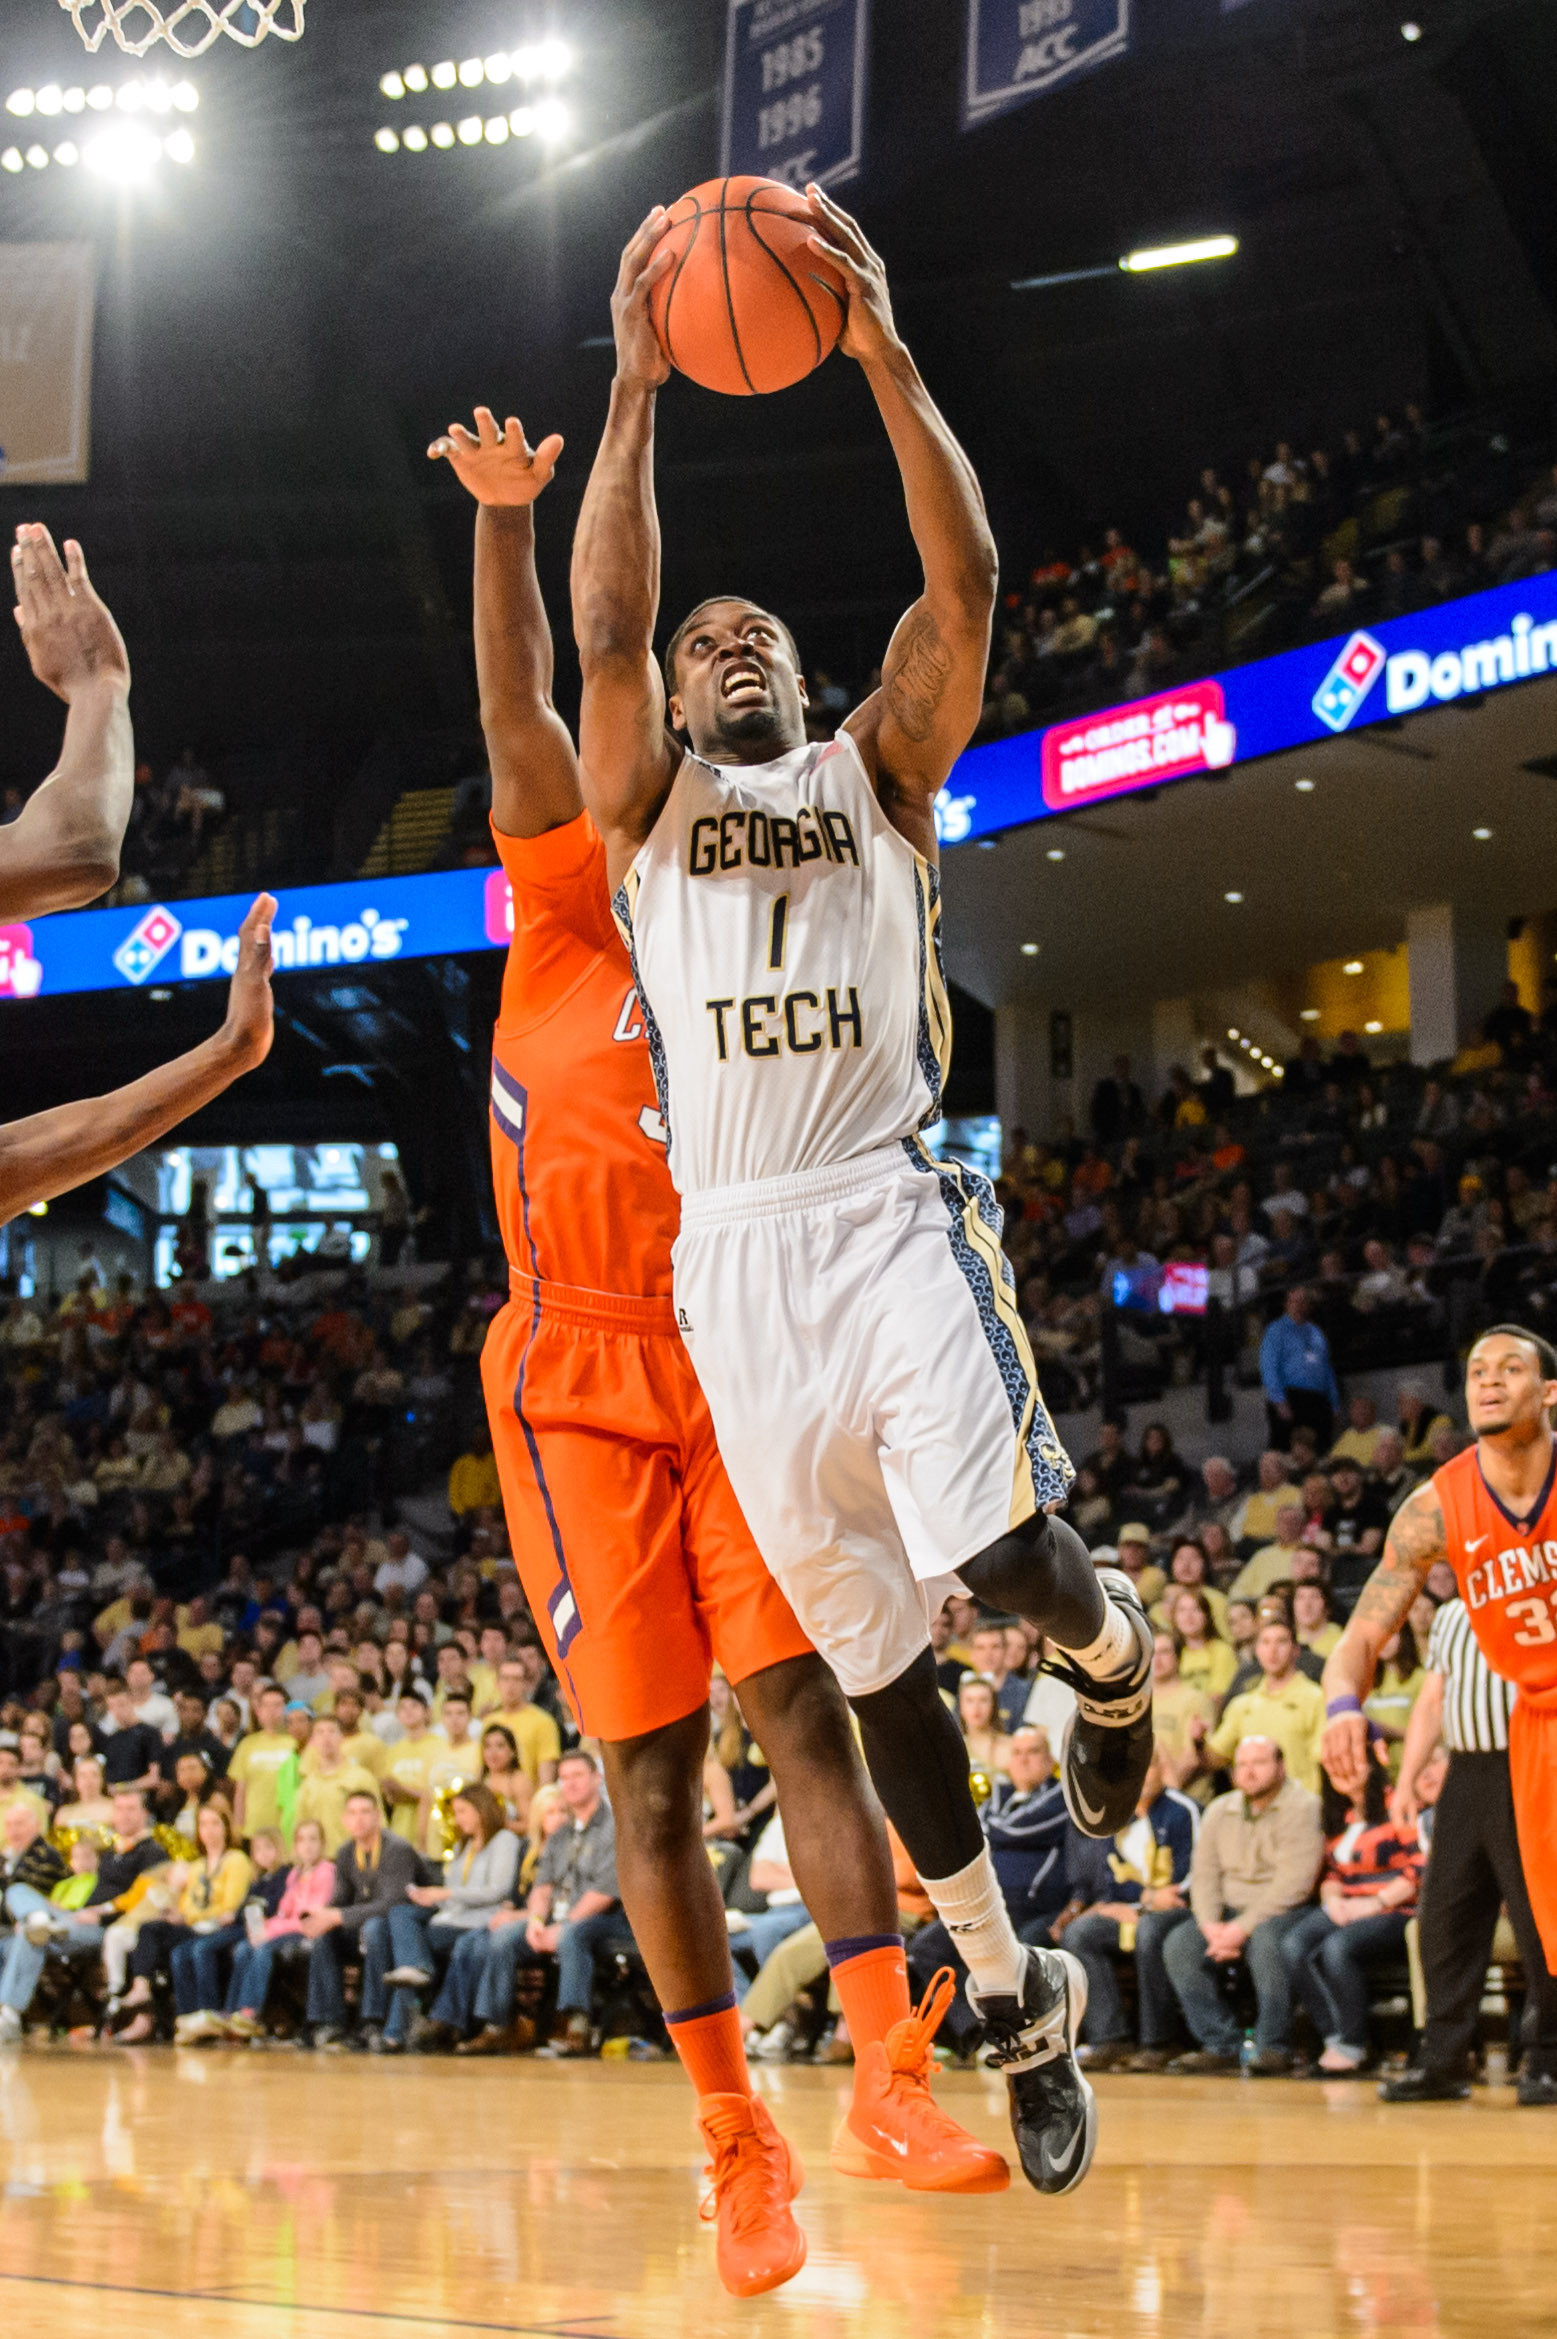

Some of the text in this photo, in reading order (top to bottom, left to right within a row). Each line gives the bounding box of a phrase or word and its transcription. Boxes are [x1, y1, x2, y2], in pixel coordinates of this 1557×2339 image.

[1013, 23, 1079, 82] ACC
[767, 149, 818, 190] CC
[1386, 612, 1557, 714] Domin
[689, 805, 861, 877] GEORGIA
[767, 889, 791, 972] 1
[612, 986, 650, 1042] C
[705, 986, 862, 1064] TECH
[1466, 1539, 1557, 1611] CLEMS
[1504, 1588, 1557, 1647] 3
